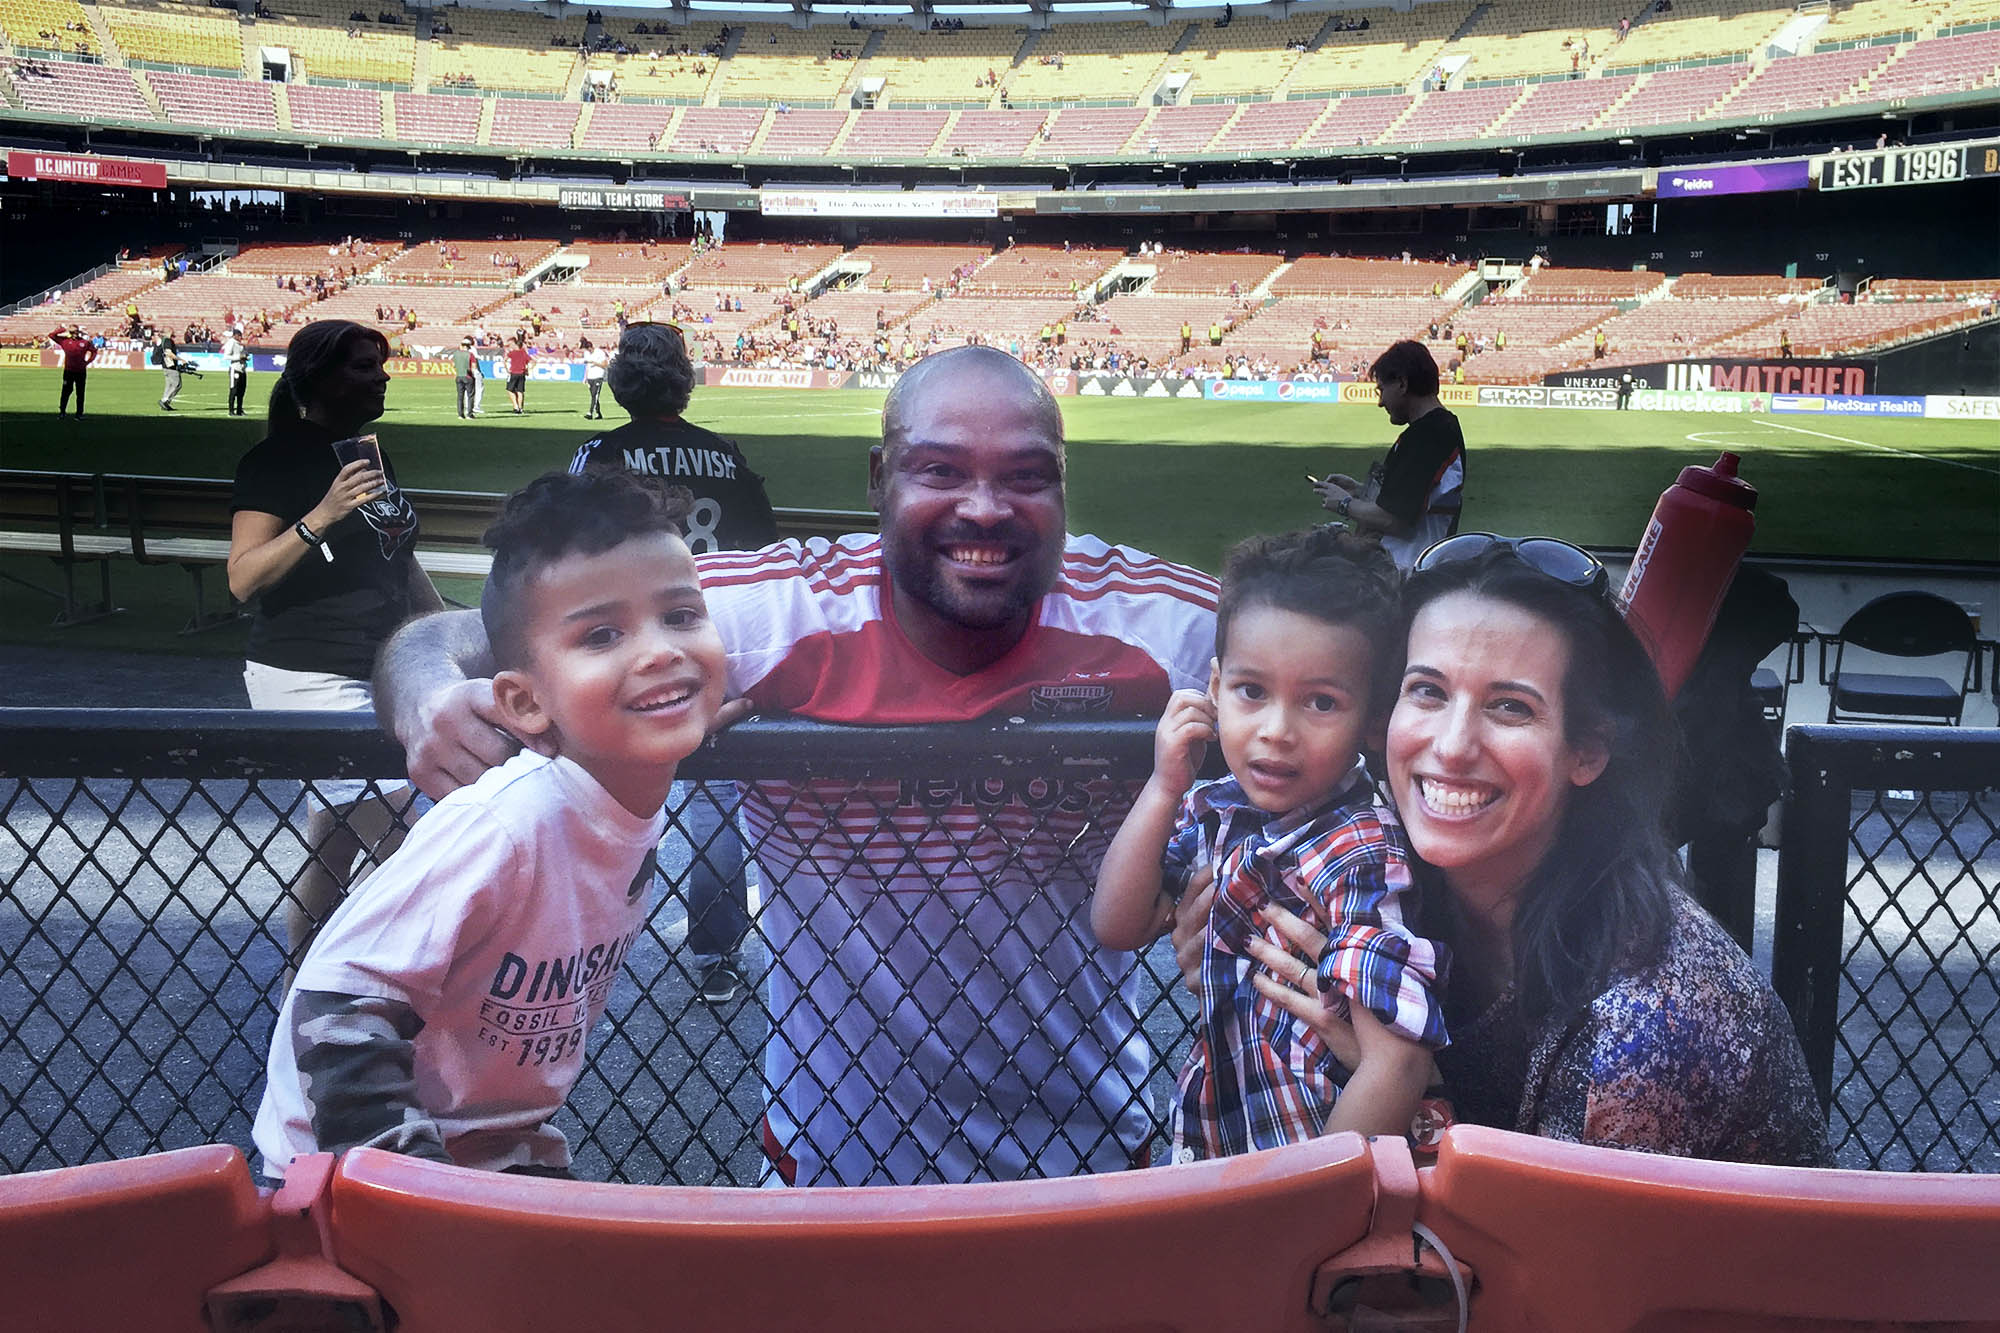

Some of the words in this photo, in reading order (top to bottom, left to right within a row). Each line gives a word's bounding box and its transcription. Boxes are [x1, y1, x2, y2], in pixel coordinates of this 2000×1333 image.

[101, 163, 143, 179] CAMPS
[1832, 156, 1877, 187] EST.
[1901, 149, 1958, 181] 1996
[1684, 178, 1713, 191] leidos
[561, 190, 604, 206] OFFICIAL
[604, 191, 631, 207] TEAM
[634, 192, 664, 208] STORE
[7, 353, 40, 363] TIRE
[725, 371, 808, 386] ADVOCARE
[1666, 363, 1865, 396] UNMATCHED
[1230, 383, 1264, 397] pepsi
[1296, 385, 1331, 399] pepsi
[1441, 390, 1473, 401] TIRE
[1826, 399, 1878, 412] MedStar
[1879, 400, 1922, 413] Health
[683, 497, 722, 554] 8
[480, 1002, 560, 1031] FOSSIL
[478, 1026, 514, 1054] EST.
[516, 1028, 583, 1066] 1939
